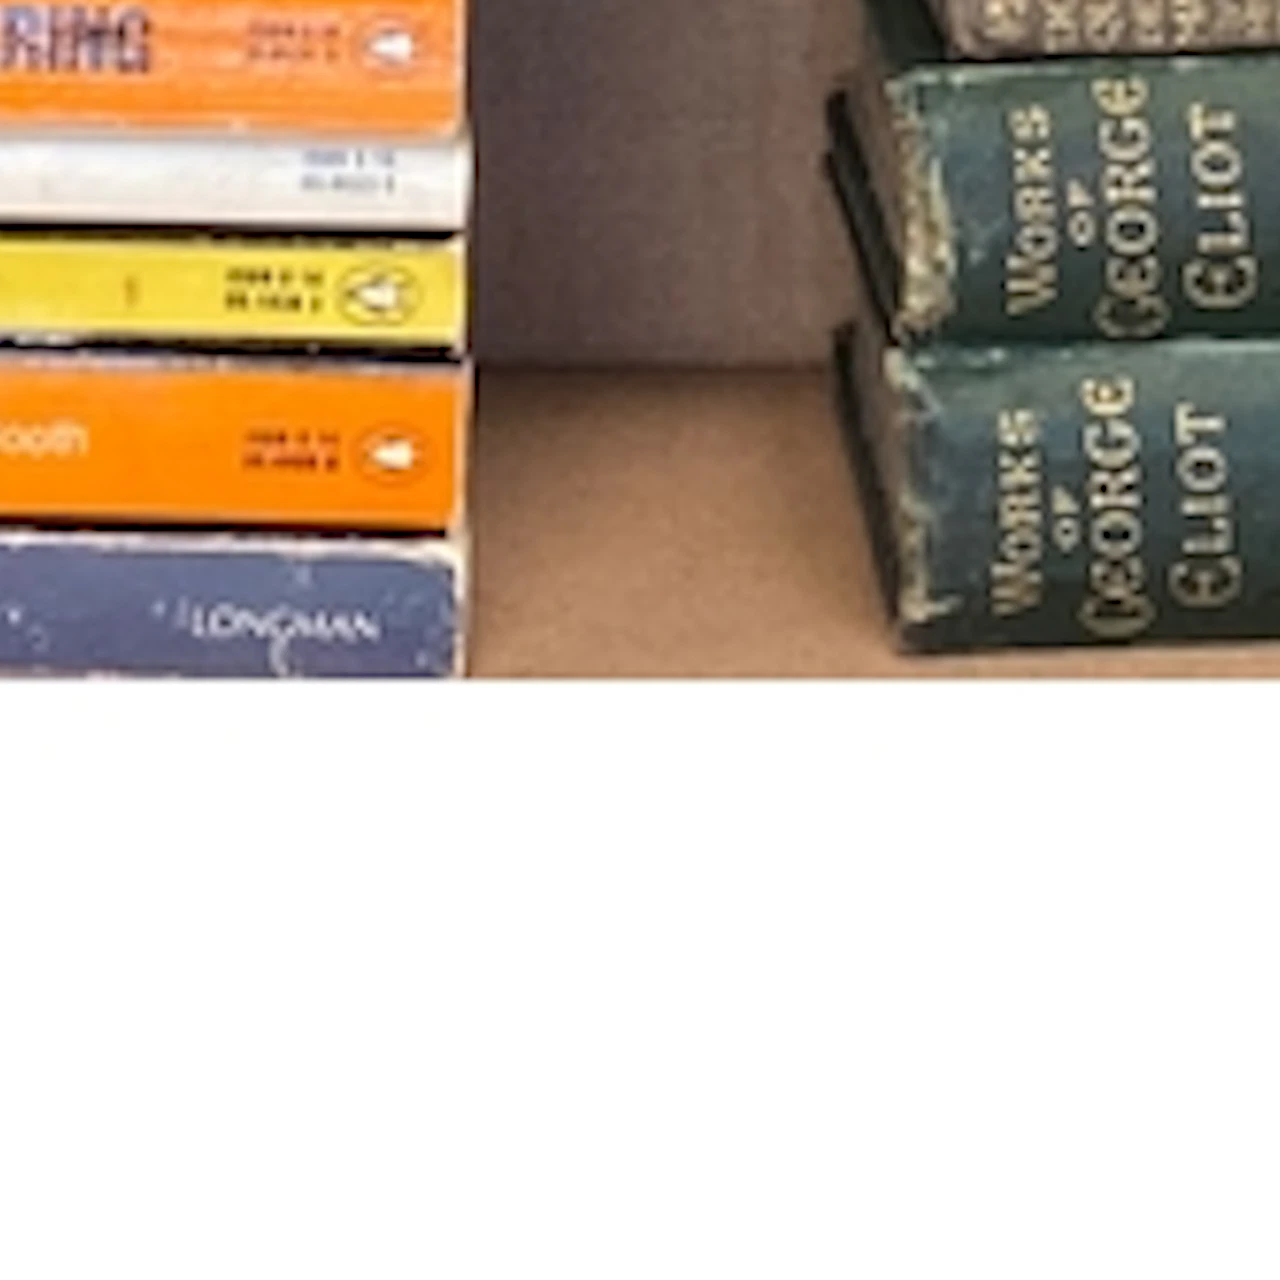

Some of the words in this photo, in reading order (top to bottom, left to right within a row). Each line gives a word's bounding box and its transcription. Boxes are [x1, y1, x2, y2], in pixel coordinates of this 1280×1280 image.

[1003, 103, 1058, 316] WORKS
[1066, 177, 1096, 250] OF
[1090, 73, 1171, 338] GEORGE
[1181, 101, 1259, 309] ELIOT
[990, 407, 1046, 616] WORKS
[1051, 483, 1078, 552] OF
[1078, 372, 1157, 635] GEORGE
[1168, 398, 1244, 610] ELIOT
[190, 602, 382, 646] LONGMAN
